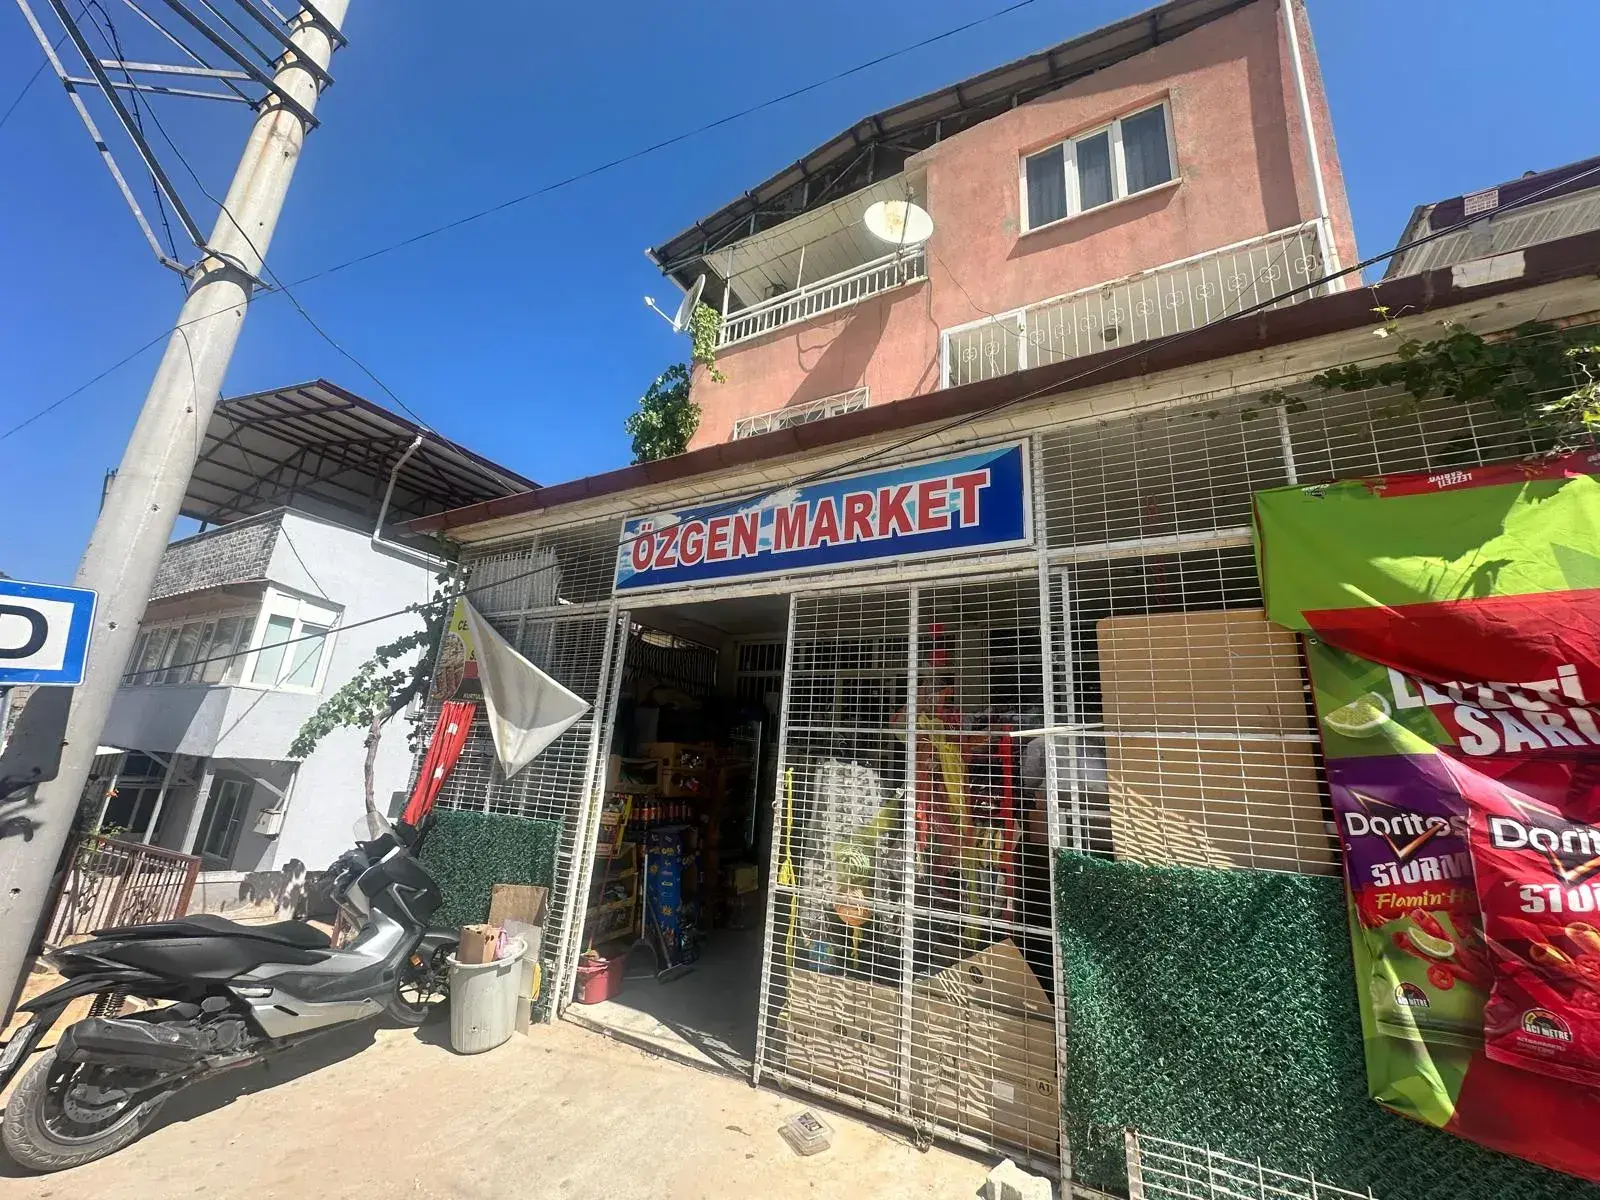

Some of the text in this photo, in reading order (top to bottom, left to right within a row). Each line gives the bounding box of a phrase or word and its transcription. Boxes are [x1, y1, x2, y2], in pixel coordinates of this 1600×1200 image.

[631, 468, 991, 573] ÖZGEN MARKET
[1453, 705, 1600, 756] SARI
[1344, 812, 1467, 837] Doritos
[1525, 1023, 1570, 1041] ACI METRE
